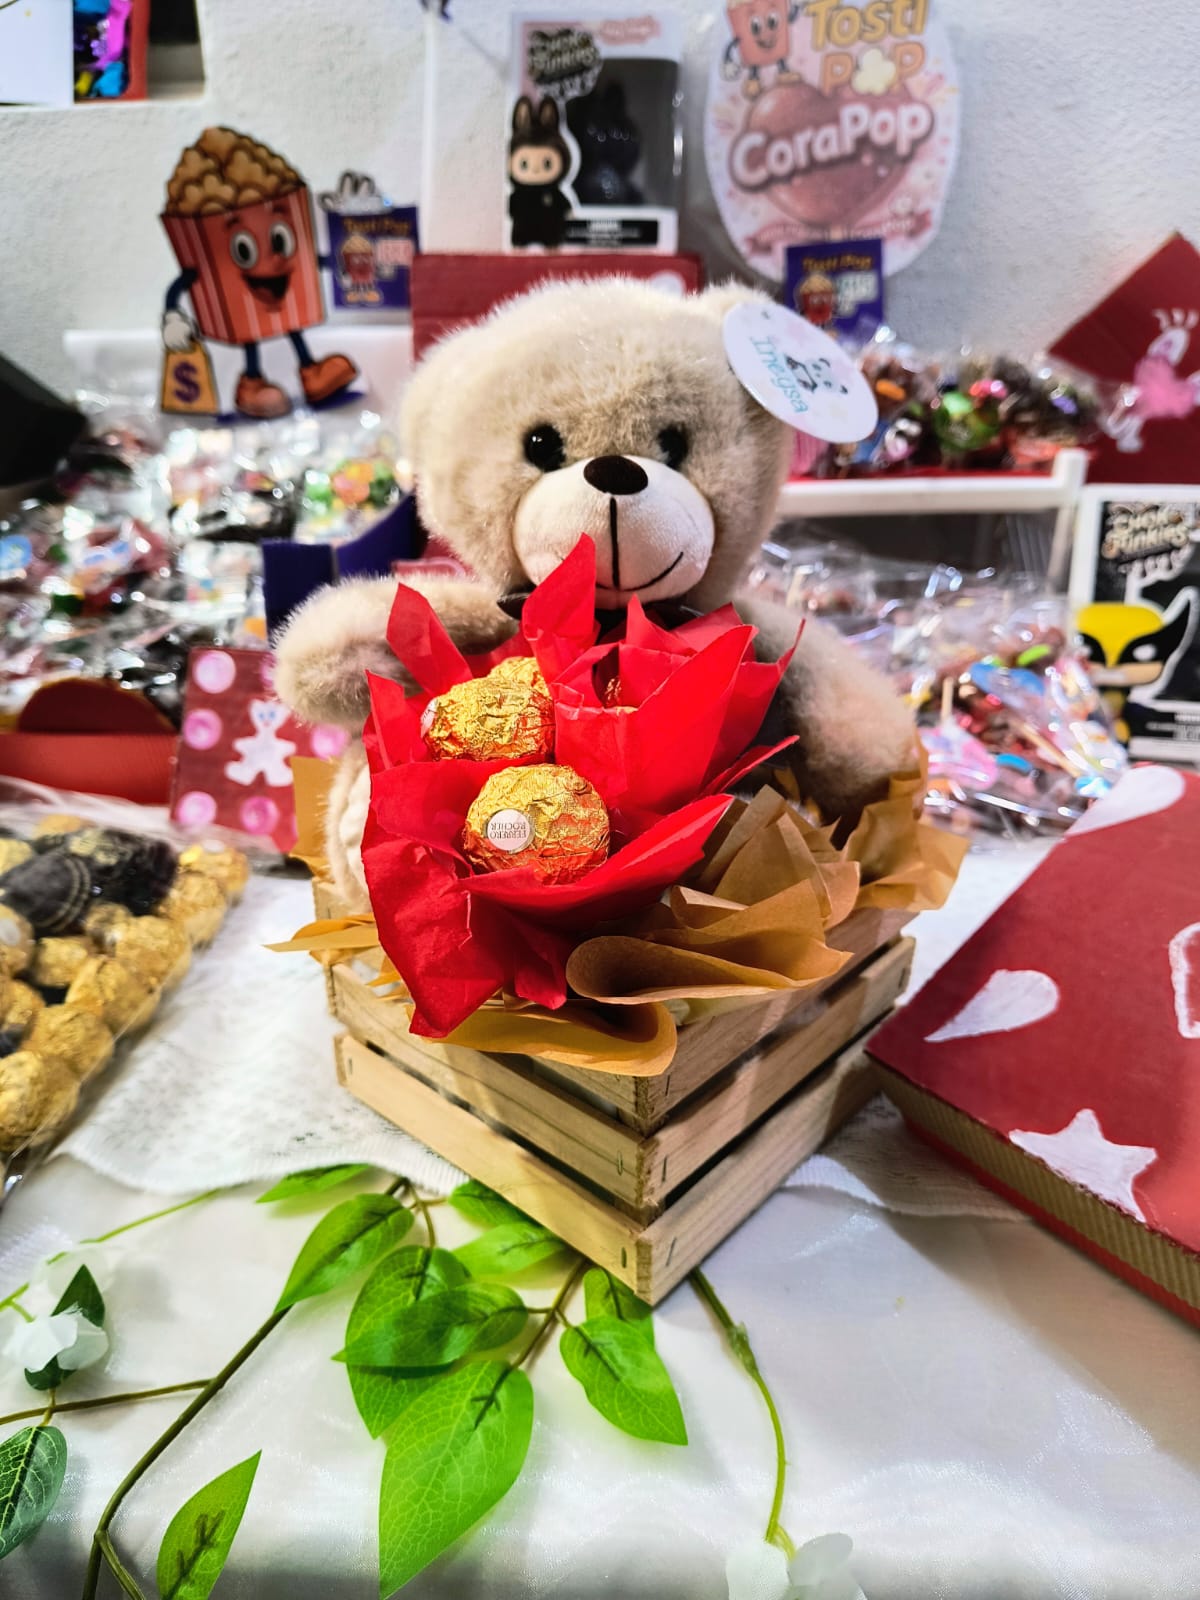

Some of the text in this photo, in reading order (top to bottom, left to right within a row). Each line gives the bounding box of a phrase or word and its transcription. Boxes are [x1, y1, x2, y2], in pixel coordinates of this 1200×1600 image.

[731, 104, 931, 186] CoraPop
[490, 821, 526, 831] ROCHER
[490, 830, 527, 840] FERRERO
